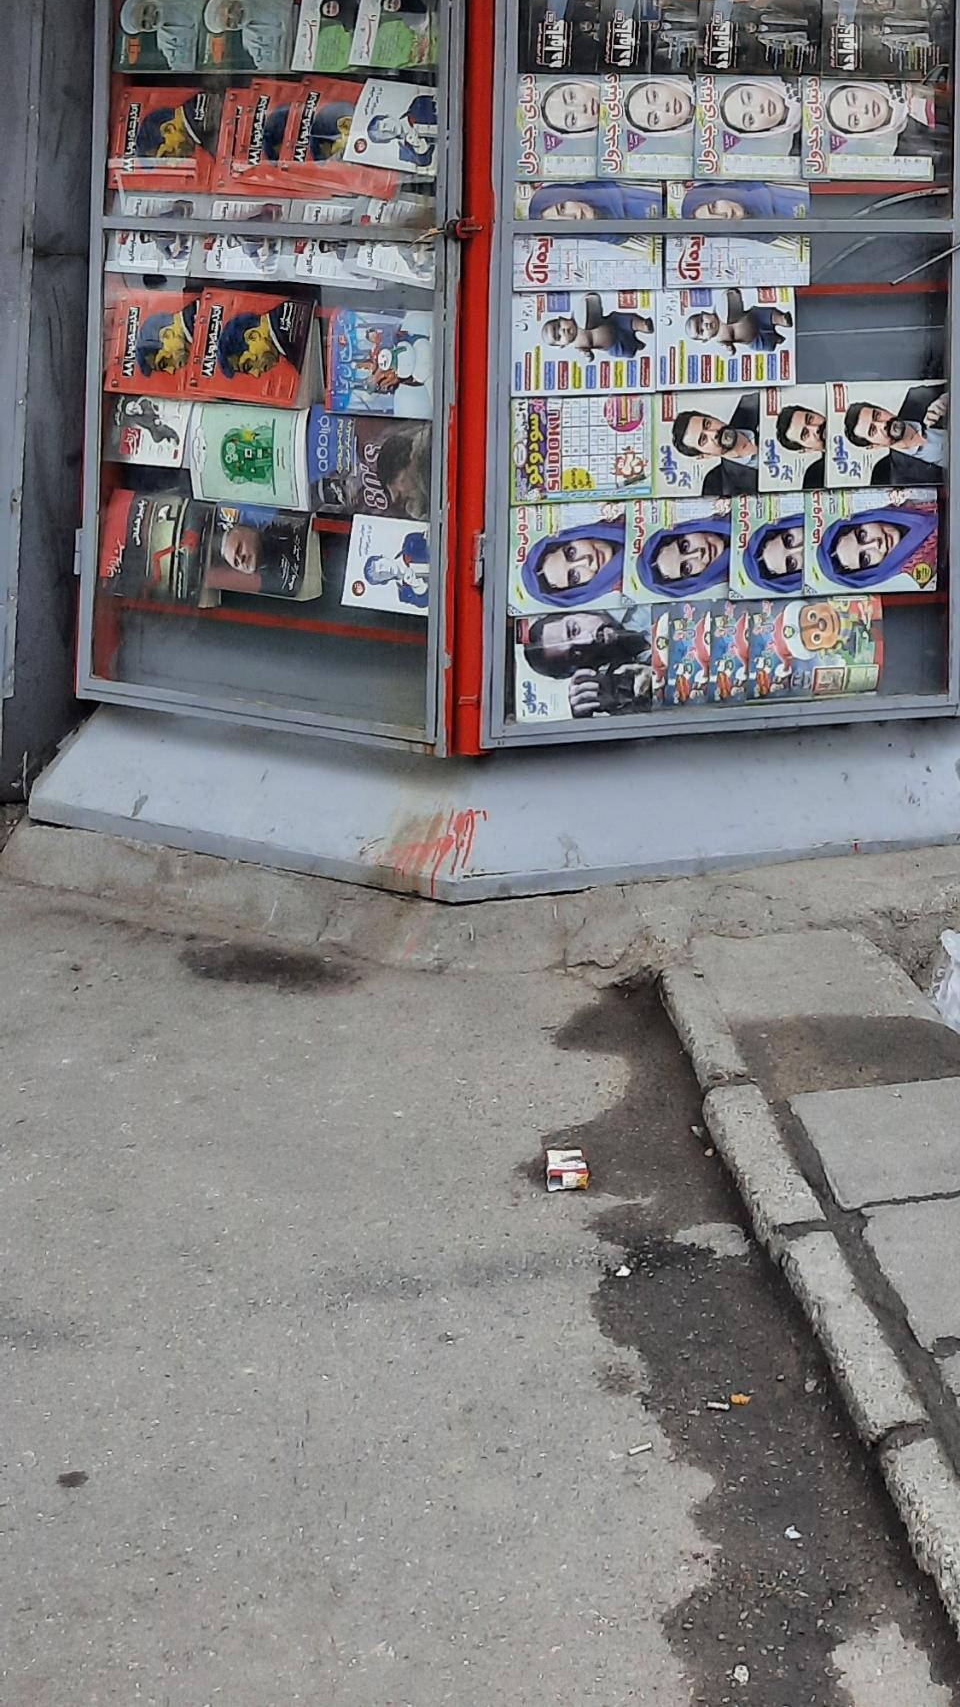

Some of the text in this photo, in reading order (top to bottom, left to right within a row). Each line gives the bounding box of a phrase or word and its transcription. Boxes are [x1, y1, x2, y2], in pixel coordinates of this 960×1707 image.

[544, 19, 567, 68] خانواده
[612, 18, 635, 66] خانواده
[710, 21, 732, 68] خانواده
[838, 22, 857, 70] خانواده
[127, 102, 141, 138] اندیشه
[253, 95, 270, 131] اندیشه
[301, 92, 319, 128] اندیشه
[518, 74, 538, 174] دنیای جدول
[600, 72, 622, 172] دنیای جدول
[697, 75, 718, 173] دنیای جدول
[805, 76, 824, 173] دنیای جدول
[126, 138, 137, 156] پویا
[250, 131, 263, 149] پویا
[298, 127, 312, 144] پویا
[123, 307, 138, 376] اندیشه پویا ۸۸
[202, 305, 222, 377] اندیشه پویا ۸۸
[526, 414, 544, 485] سودوکو
[547, 409, 560, 491] SUDOKU
[659, 445, 678, 484] عنوان
[763, 439, 780, 478] عنوان
[832, 435, 848, 473] عنوان
[521, 681, 536, 713] عنوان
